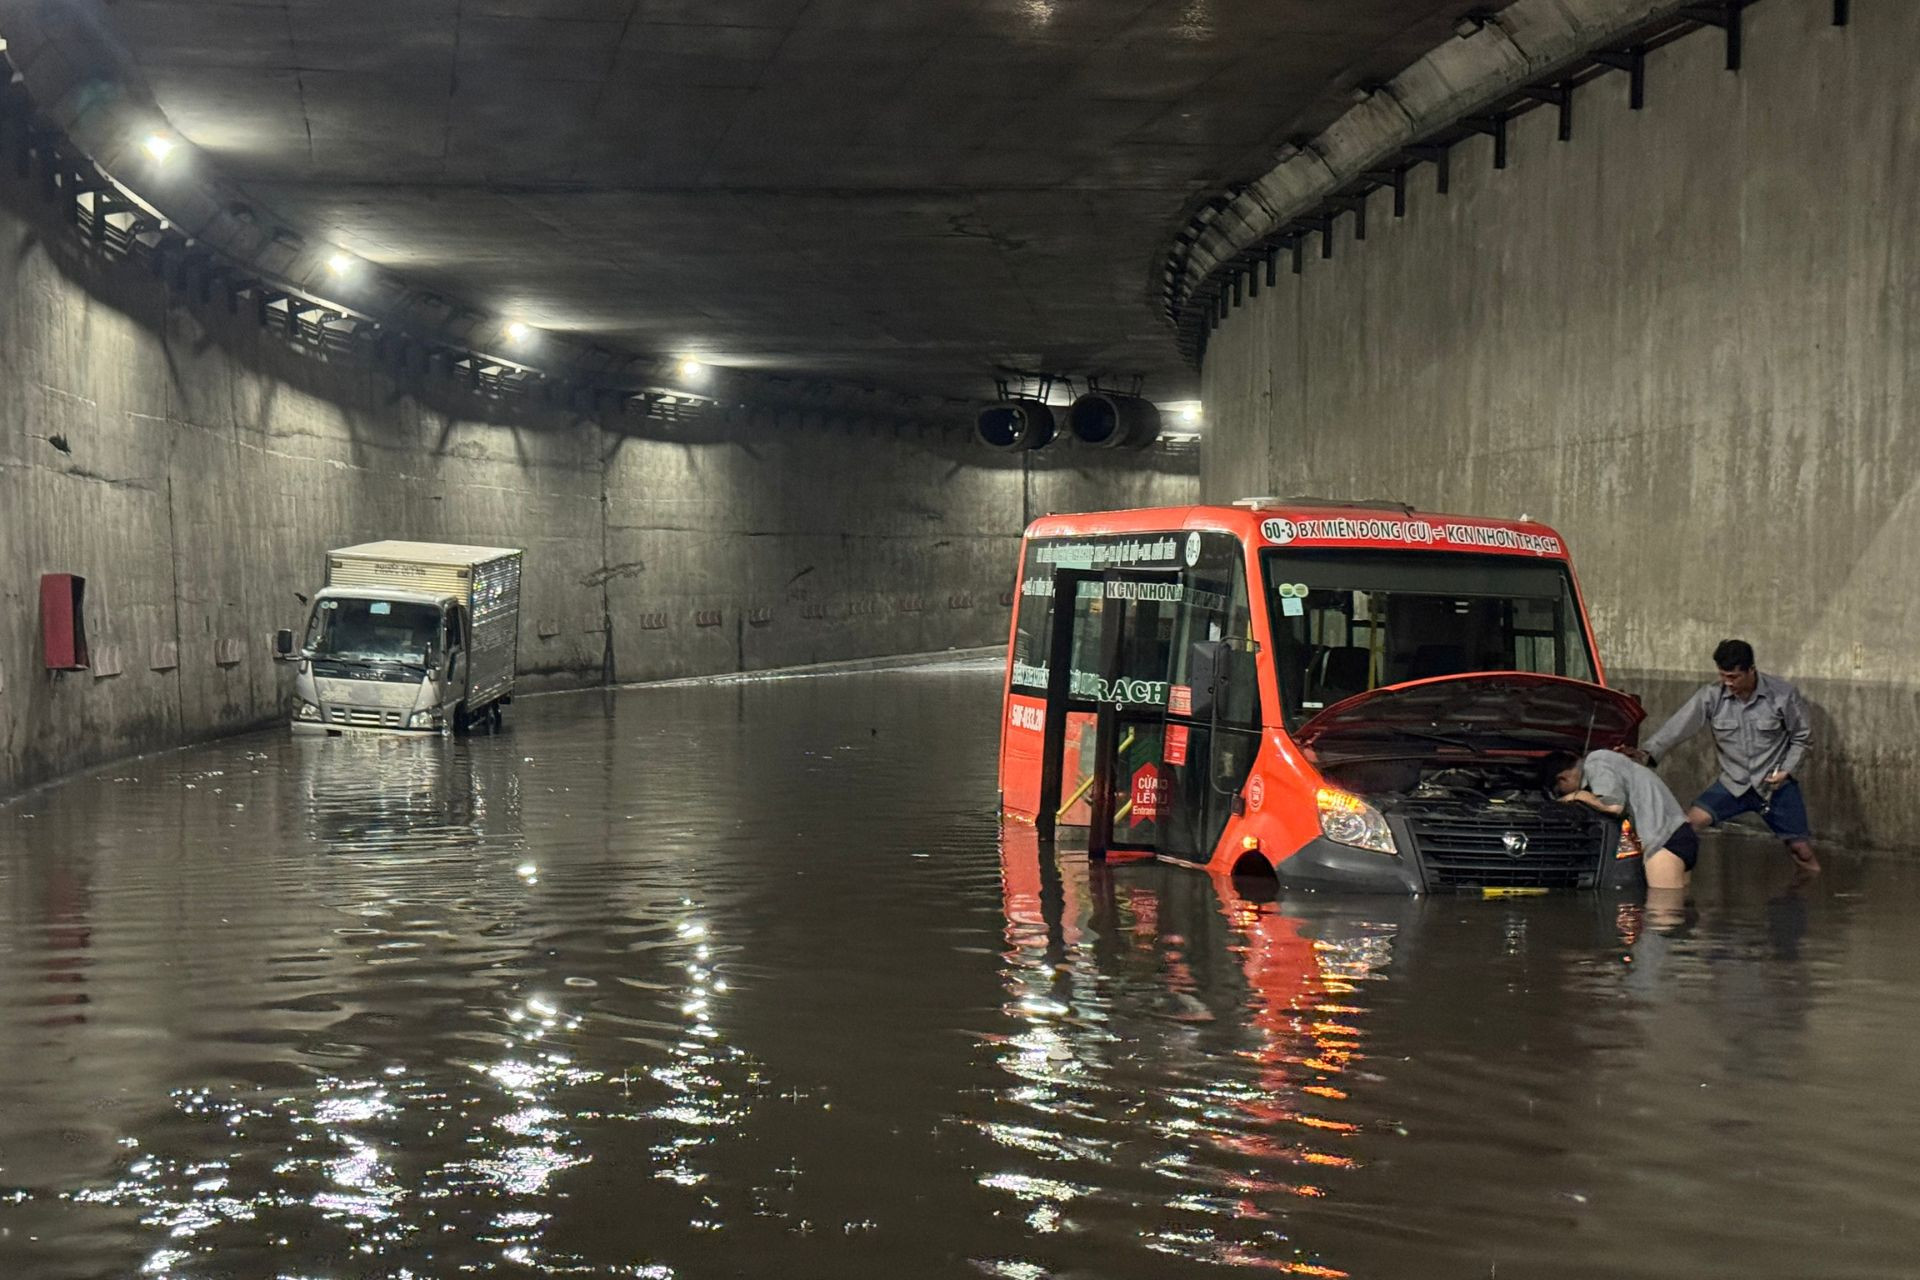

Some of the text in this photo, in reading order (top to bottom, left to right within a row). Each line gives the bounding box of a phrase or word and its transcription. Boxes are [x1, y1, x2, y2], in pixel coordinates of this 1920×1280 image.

[1263, 520, 1295, 540] 60-3
[1298, 520, 1319, 538] BX
[1446, 523, 1473, 543] KCN
[1476, 526, 1517, 548] NHƠN
[1518, 533, 1561, 556] TRẠCH
[1106, 581, 1136, 599] KCN
[1138, 583, 1177, 602] NHƠN
